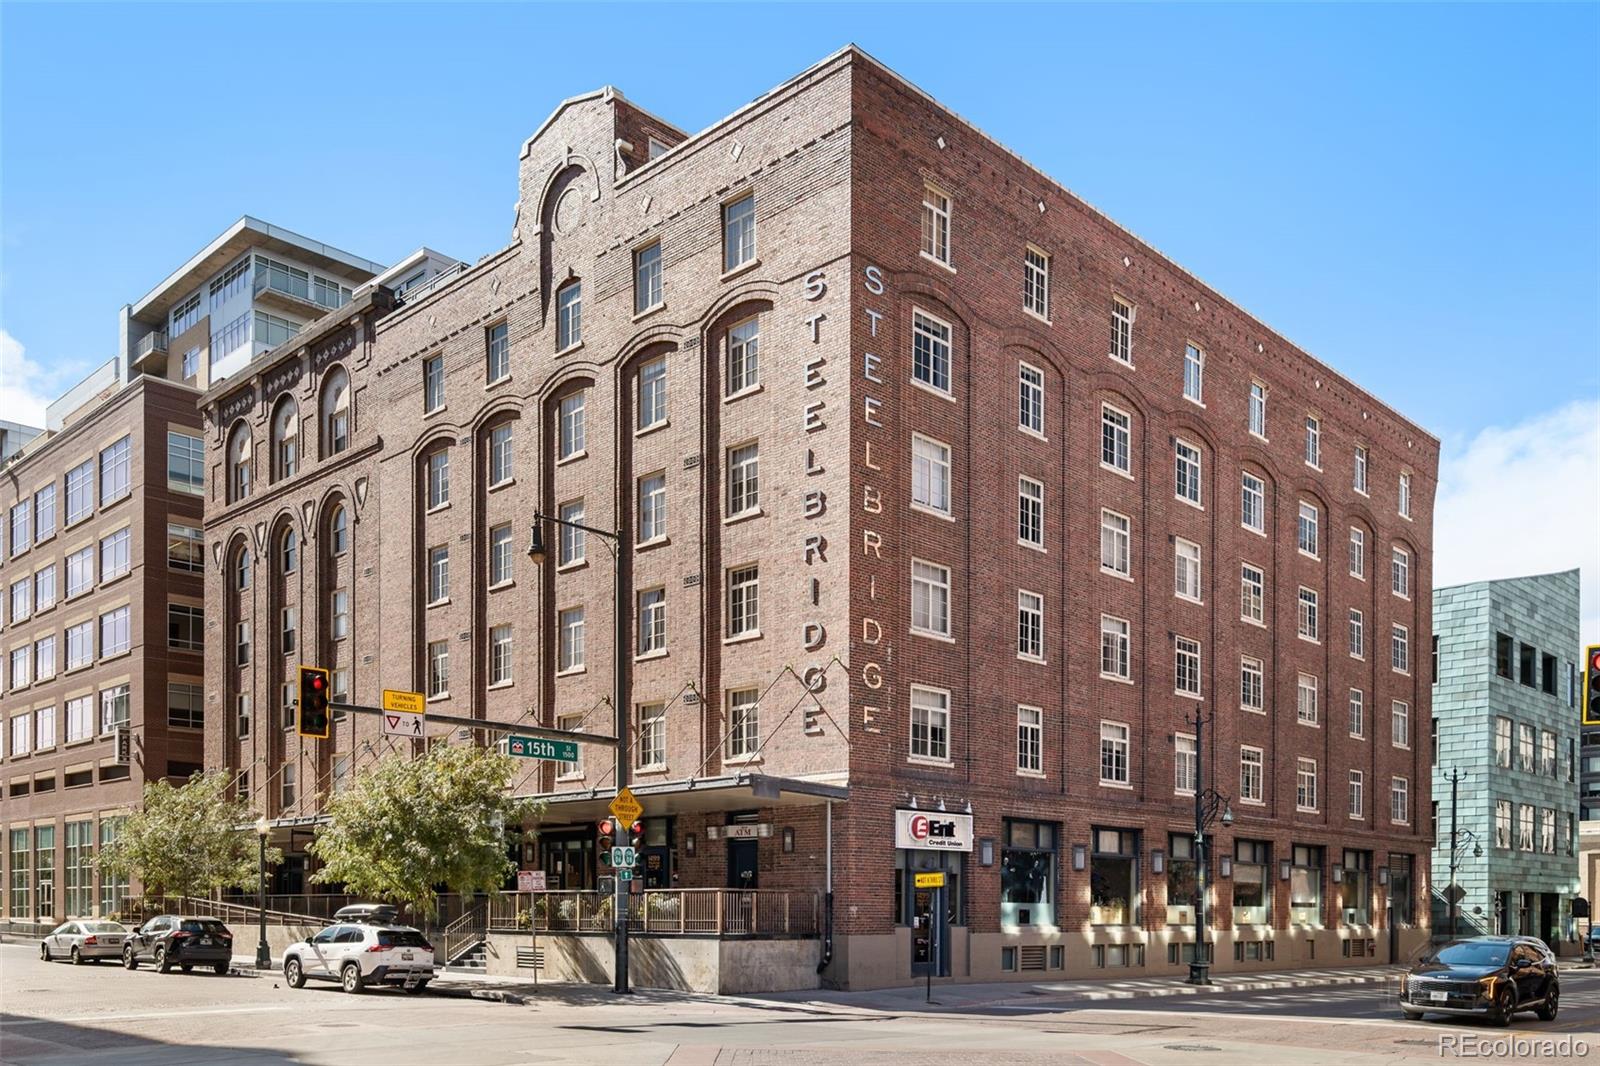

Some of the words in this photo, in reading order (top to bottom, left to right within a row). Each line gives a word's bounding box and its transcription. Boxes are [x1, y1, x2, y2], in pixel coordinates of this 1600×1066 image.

[803, 271, 827, 736] STEELBRIDGE
[863, 265, 884, 734] STEELBRIDGE
[392, 694, 416, 702] TURNING
[391, 702, 417, 710] VEHICLES
[527, 741, 555, 757] 15th
[615, 803, 639, 813] THROUGH
[928, 839, 946, 847] Credit
